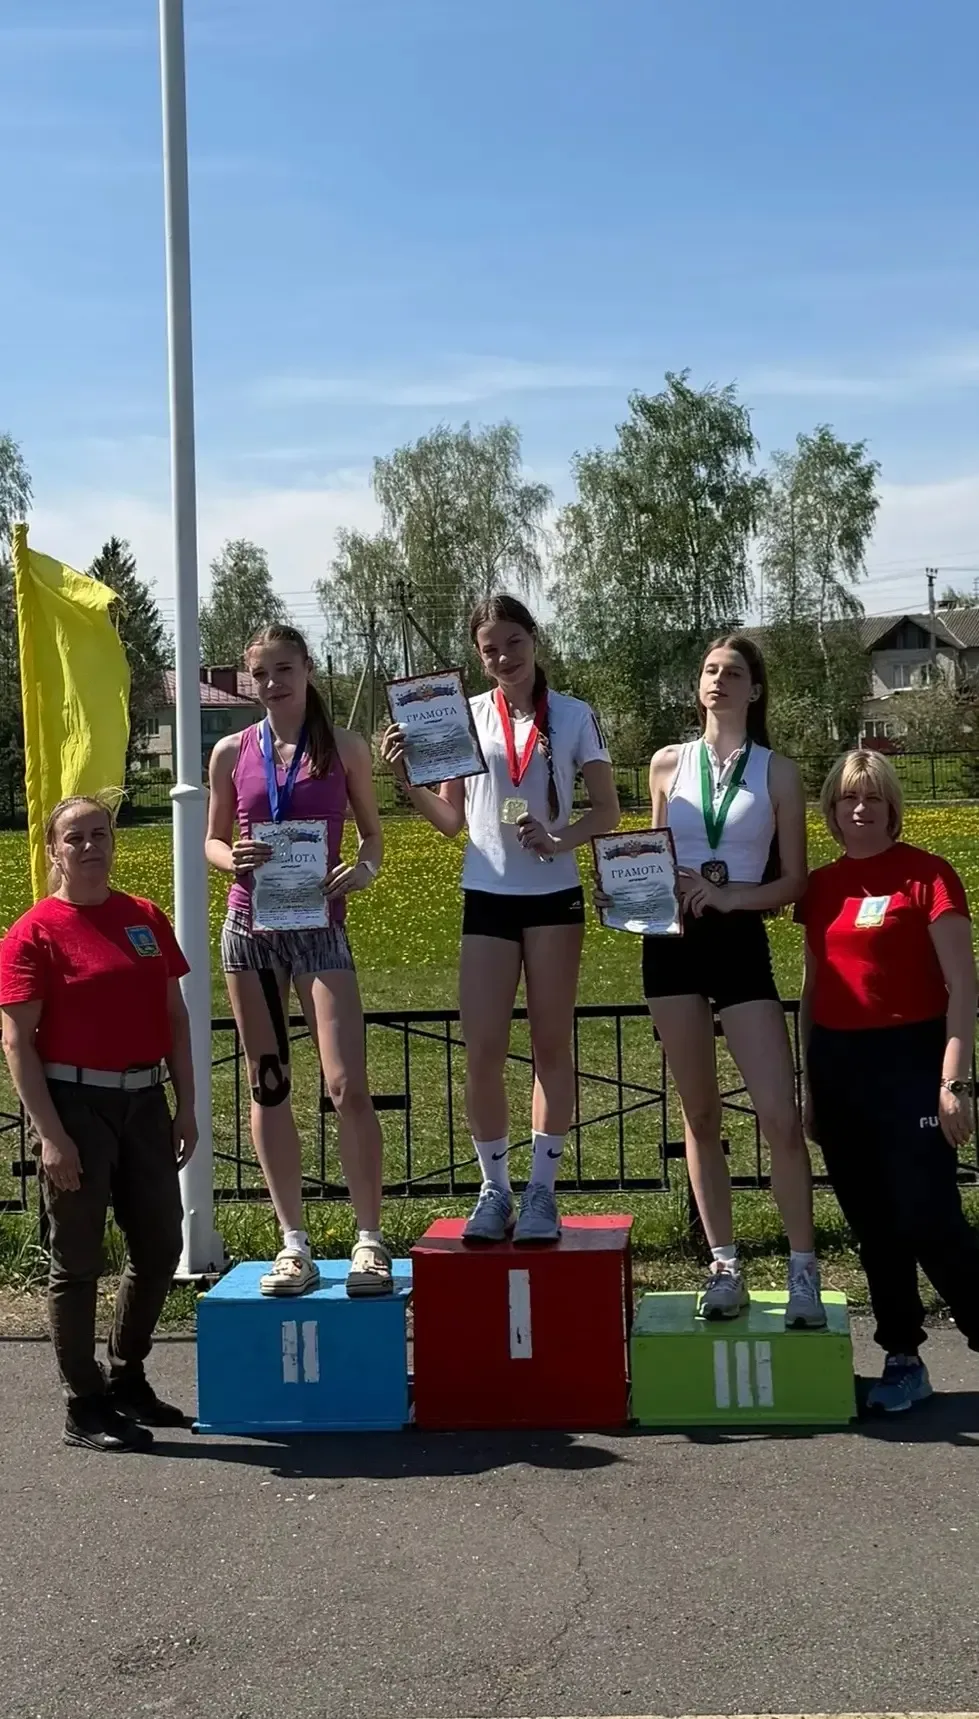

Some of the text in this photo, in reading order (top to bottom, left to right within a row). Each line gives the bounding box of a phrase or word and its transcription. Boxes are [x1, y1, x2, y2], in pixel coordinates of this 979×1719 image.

[405, 707, 458, 723] ГРАМОТА
[611, 865, 664, 879] ГРАМОТА
[713, 1340, 774, 1409] III
